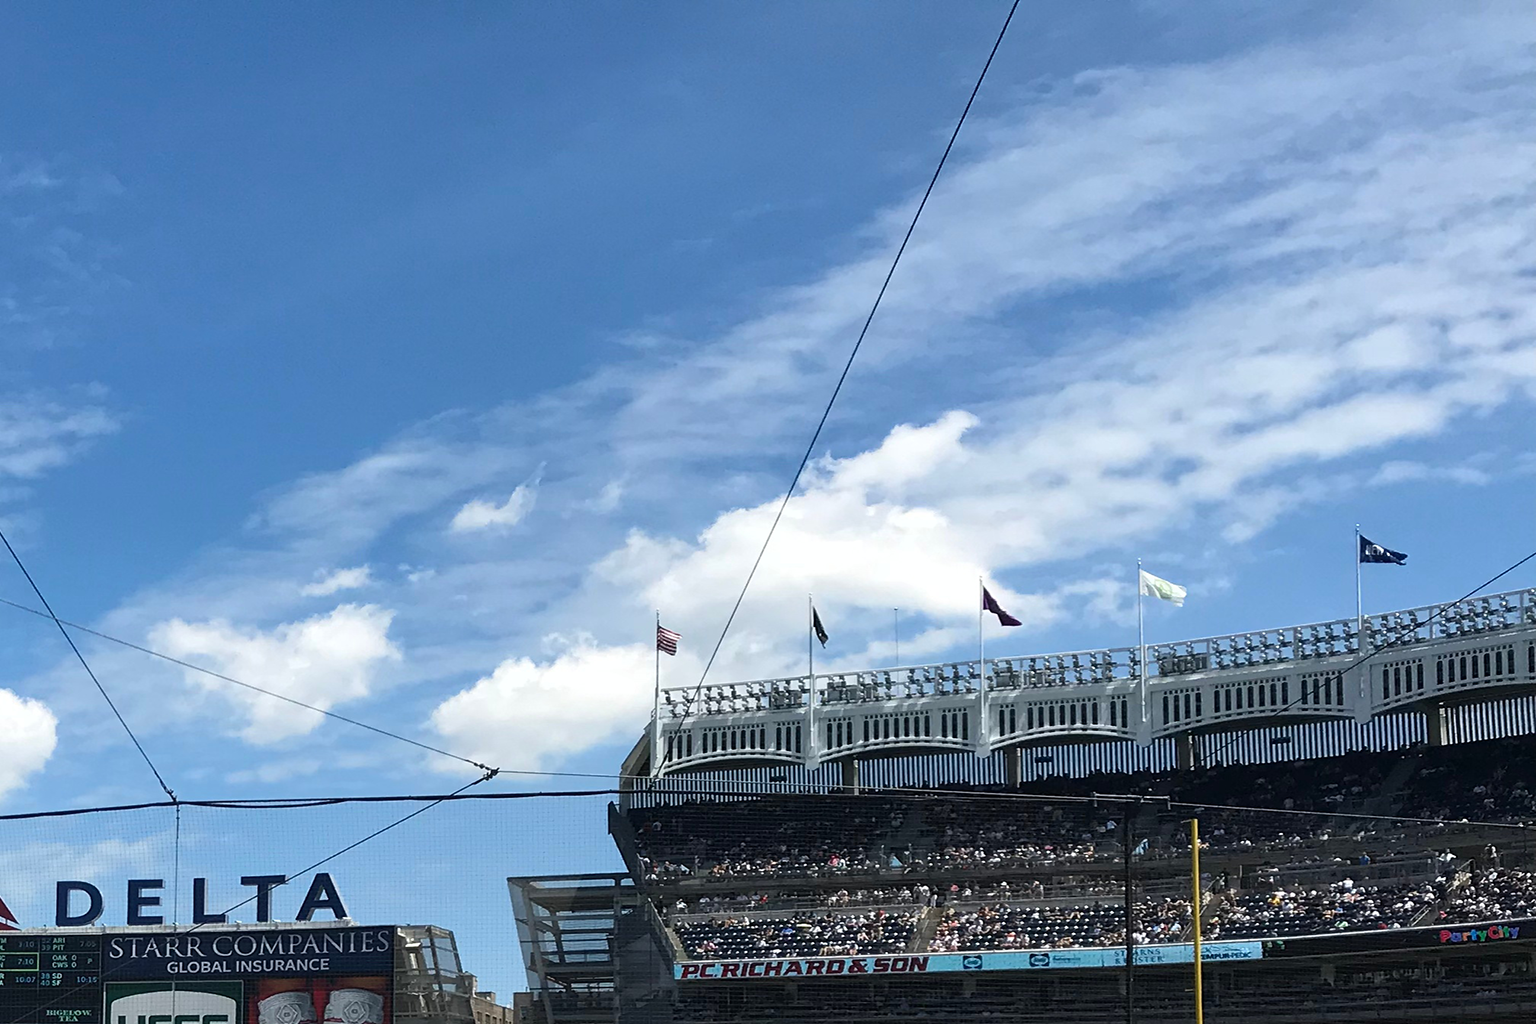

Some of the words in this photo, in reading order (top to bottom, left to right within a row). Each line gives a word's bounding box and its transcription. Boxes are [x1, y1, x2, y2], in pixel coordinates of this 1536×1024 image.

[55, 872, 350, 927] DELTA
[109, 937, 207, 960] STARR
[212, 930, 389, 957] COMPANIES
[166, 959, 231, 974] GLOBAL
[234, 956, 330, 973] INSURANCE
[680, 963, 718, 979] P.C.
[720, 959, 845, 979] RICHARD
[848, 957, 868, 975] &
[873, 956, 930, 974] SON
